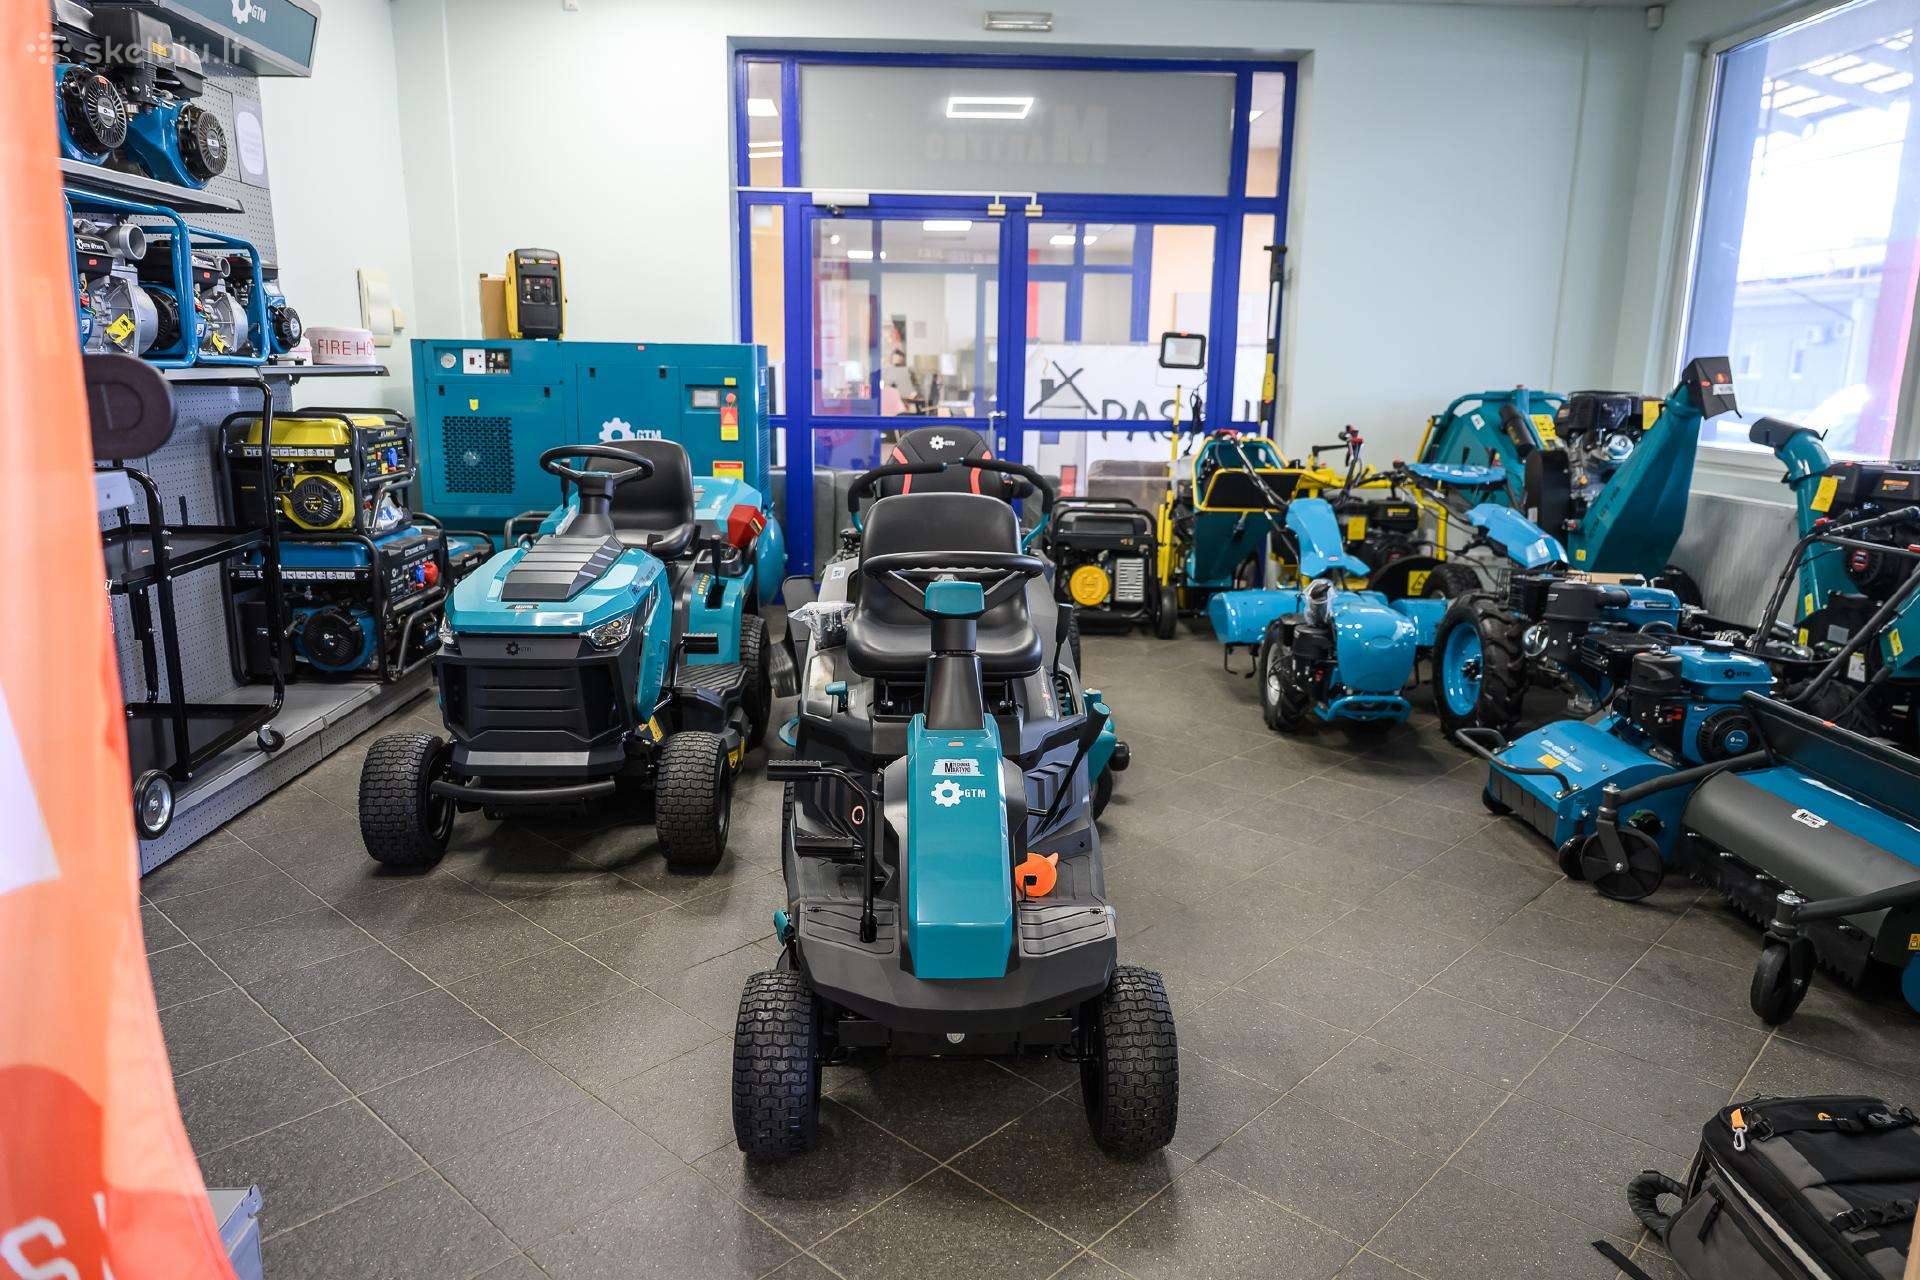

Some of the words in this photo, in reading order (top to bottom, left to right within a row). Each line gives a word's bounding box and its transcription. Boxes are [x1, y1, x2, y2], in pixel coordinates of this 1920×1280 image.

[251, 5, 268, 24] GTM
[317, 339, 352, 356] FIRE
[637, 429, 662, 440] GTM
[964, 788, 986, 798] GTM
